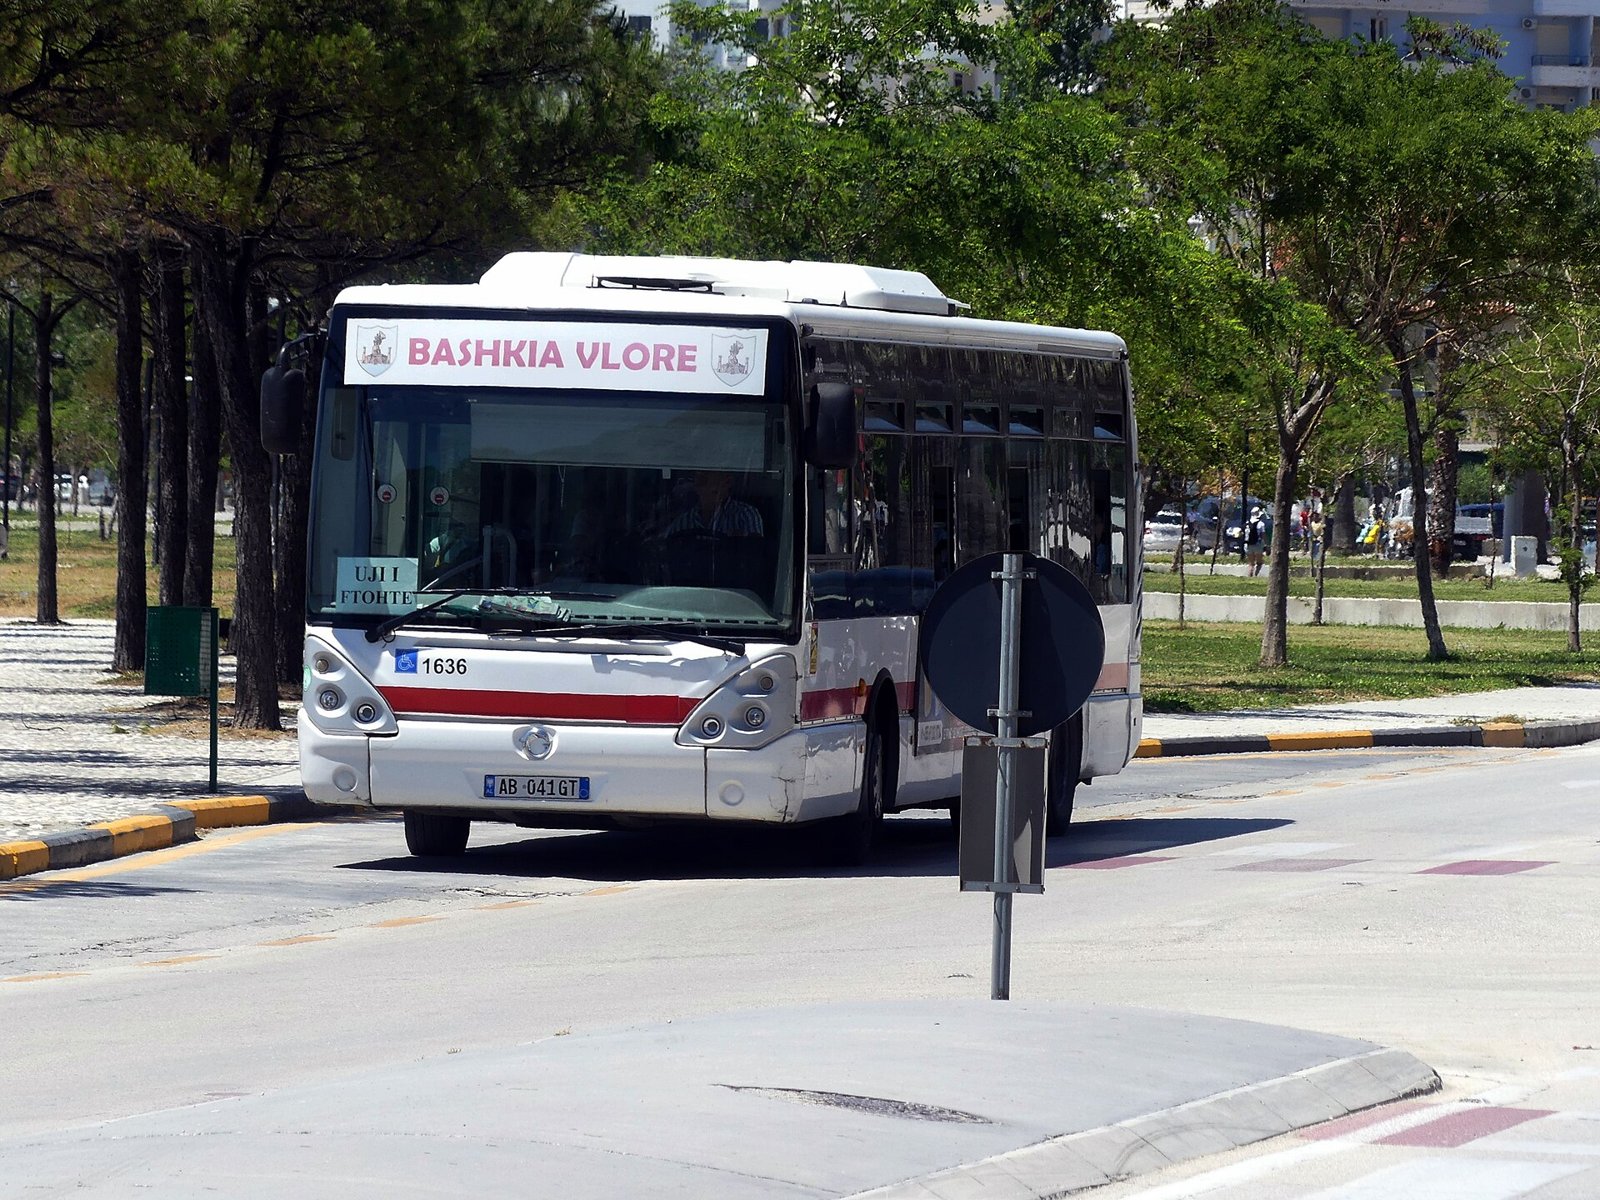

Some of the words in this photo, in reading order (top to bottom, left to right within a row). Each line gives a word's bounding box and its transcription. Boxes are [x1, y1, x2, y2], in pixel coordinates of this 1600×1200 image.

[408, 337, 565, 369] BASHKIA
[575, 341, 698, 373] VLORE
[354, 566, 385, 583] UJI
[391, 566, 400, 582] I
[340, 590, 414, 605] FTOHTE
[422, 658, 467, 675] 1636
[499, 778, 518, 795] AB
